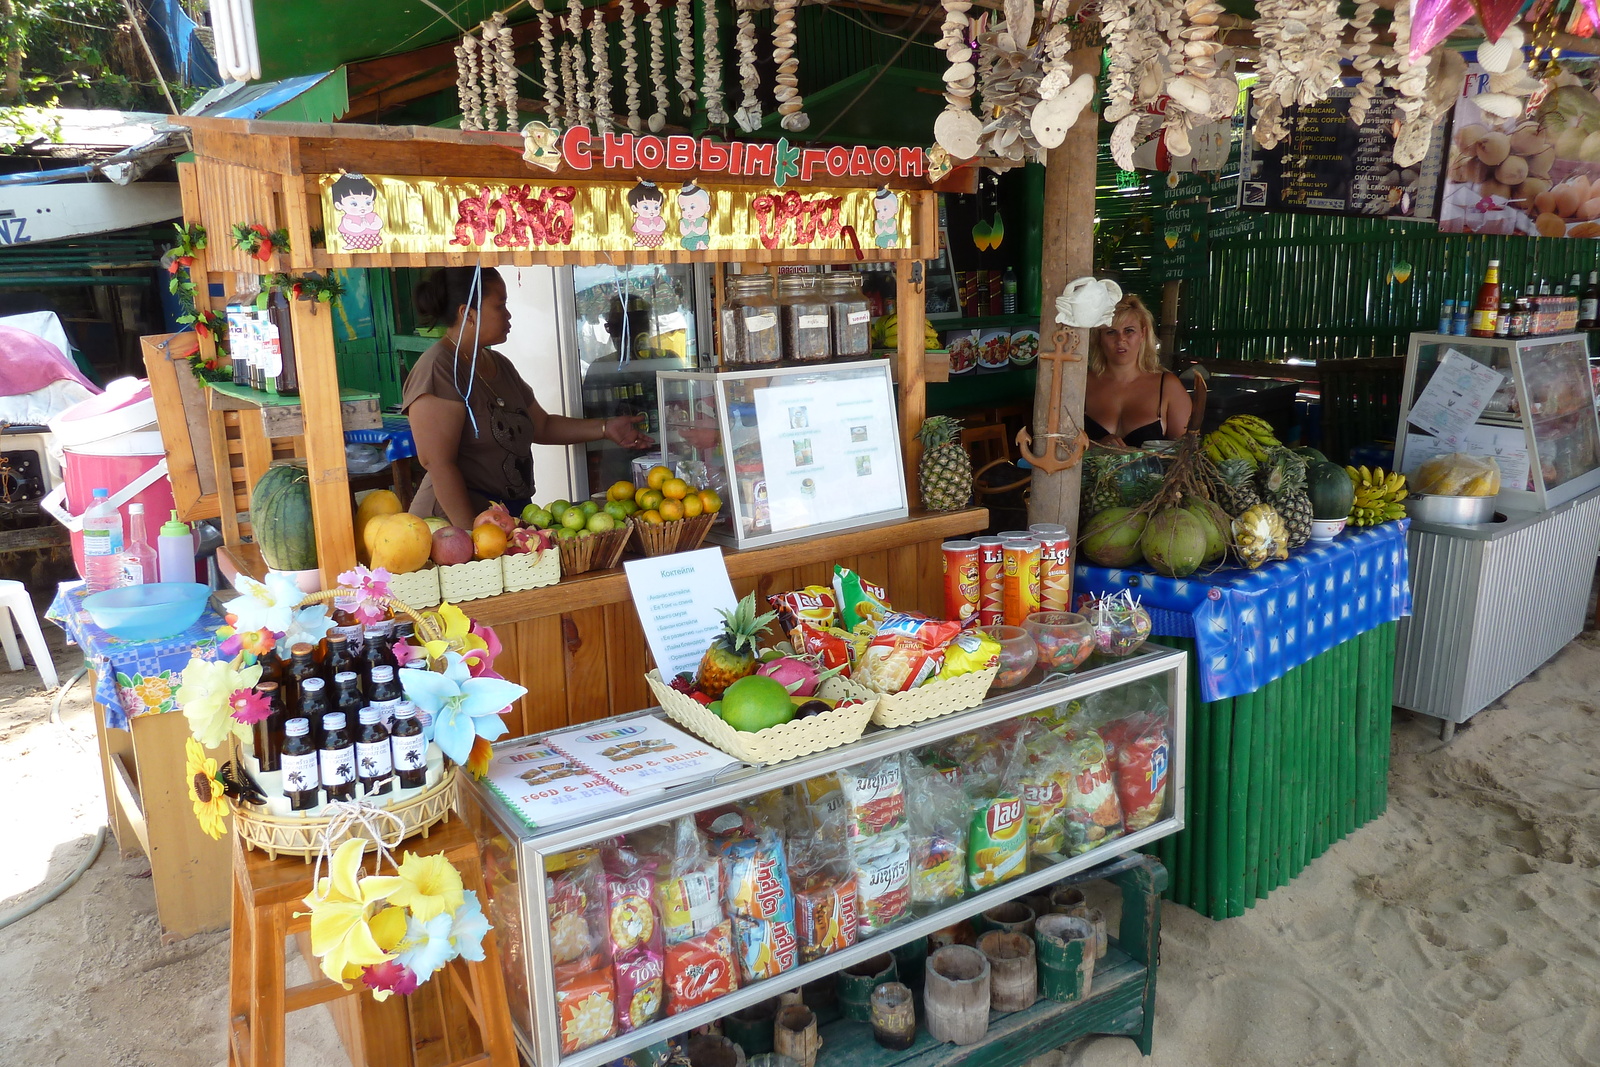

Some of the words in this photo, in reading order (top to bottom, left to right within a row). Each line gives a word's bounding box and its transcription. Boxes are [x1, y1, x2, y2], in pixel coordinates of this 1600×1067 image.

[602, 132, 774, 176] НОВЫМ
[800, 145, 923, 182] ГОДОМ
[449, 184, 577, 248] สวัสดี
[660, 566, 695, 578] Коктейли
[586, 727, 638, 742] MENU
[608, 763, 644, 776] FOOD
[662, 750, 709, 763] DRINK
[520, 788, 559, 803] FOOD
